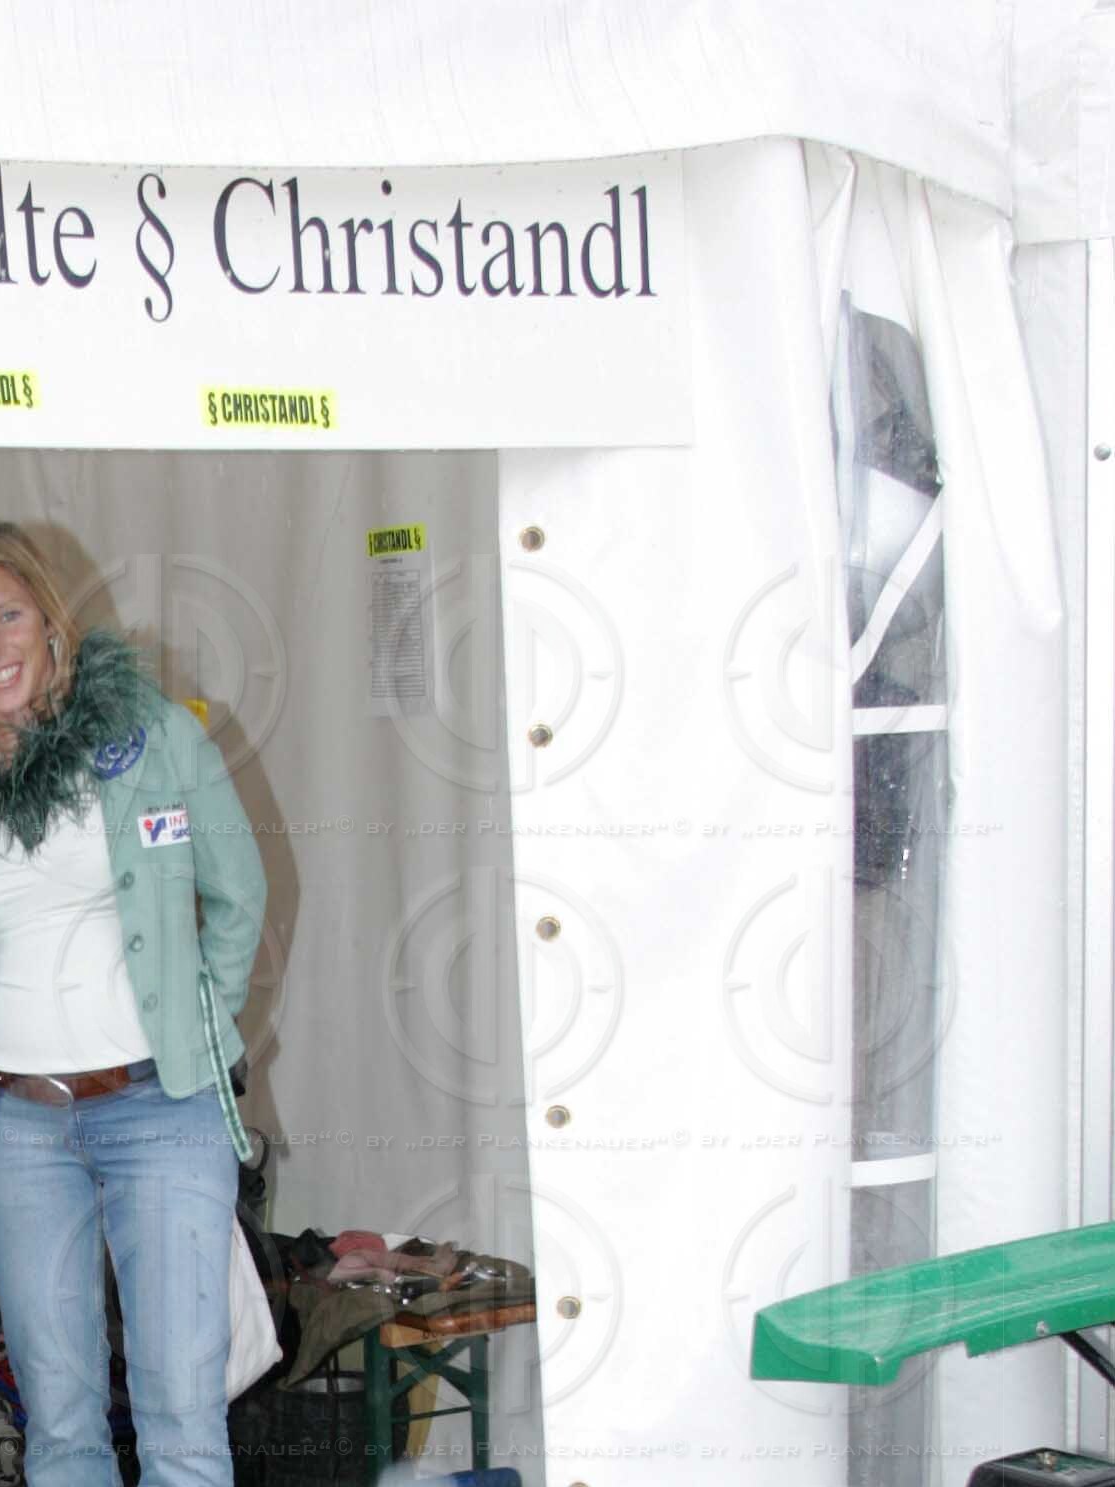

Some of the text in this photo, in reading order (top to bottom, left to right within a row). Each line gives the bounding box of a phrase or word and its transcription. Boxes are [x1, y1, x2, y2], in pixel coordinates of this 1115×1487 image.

[135, 172, 175, 322] §
[213, 176, 658, 299] Christandl
[22, 374, 34, 409] §
[207, 391, 331, 429] § CHRISTANDL §
